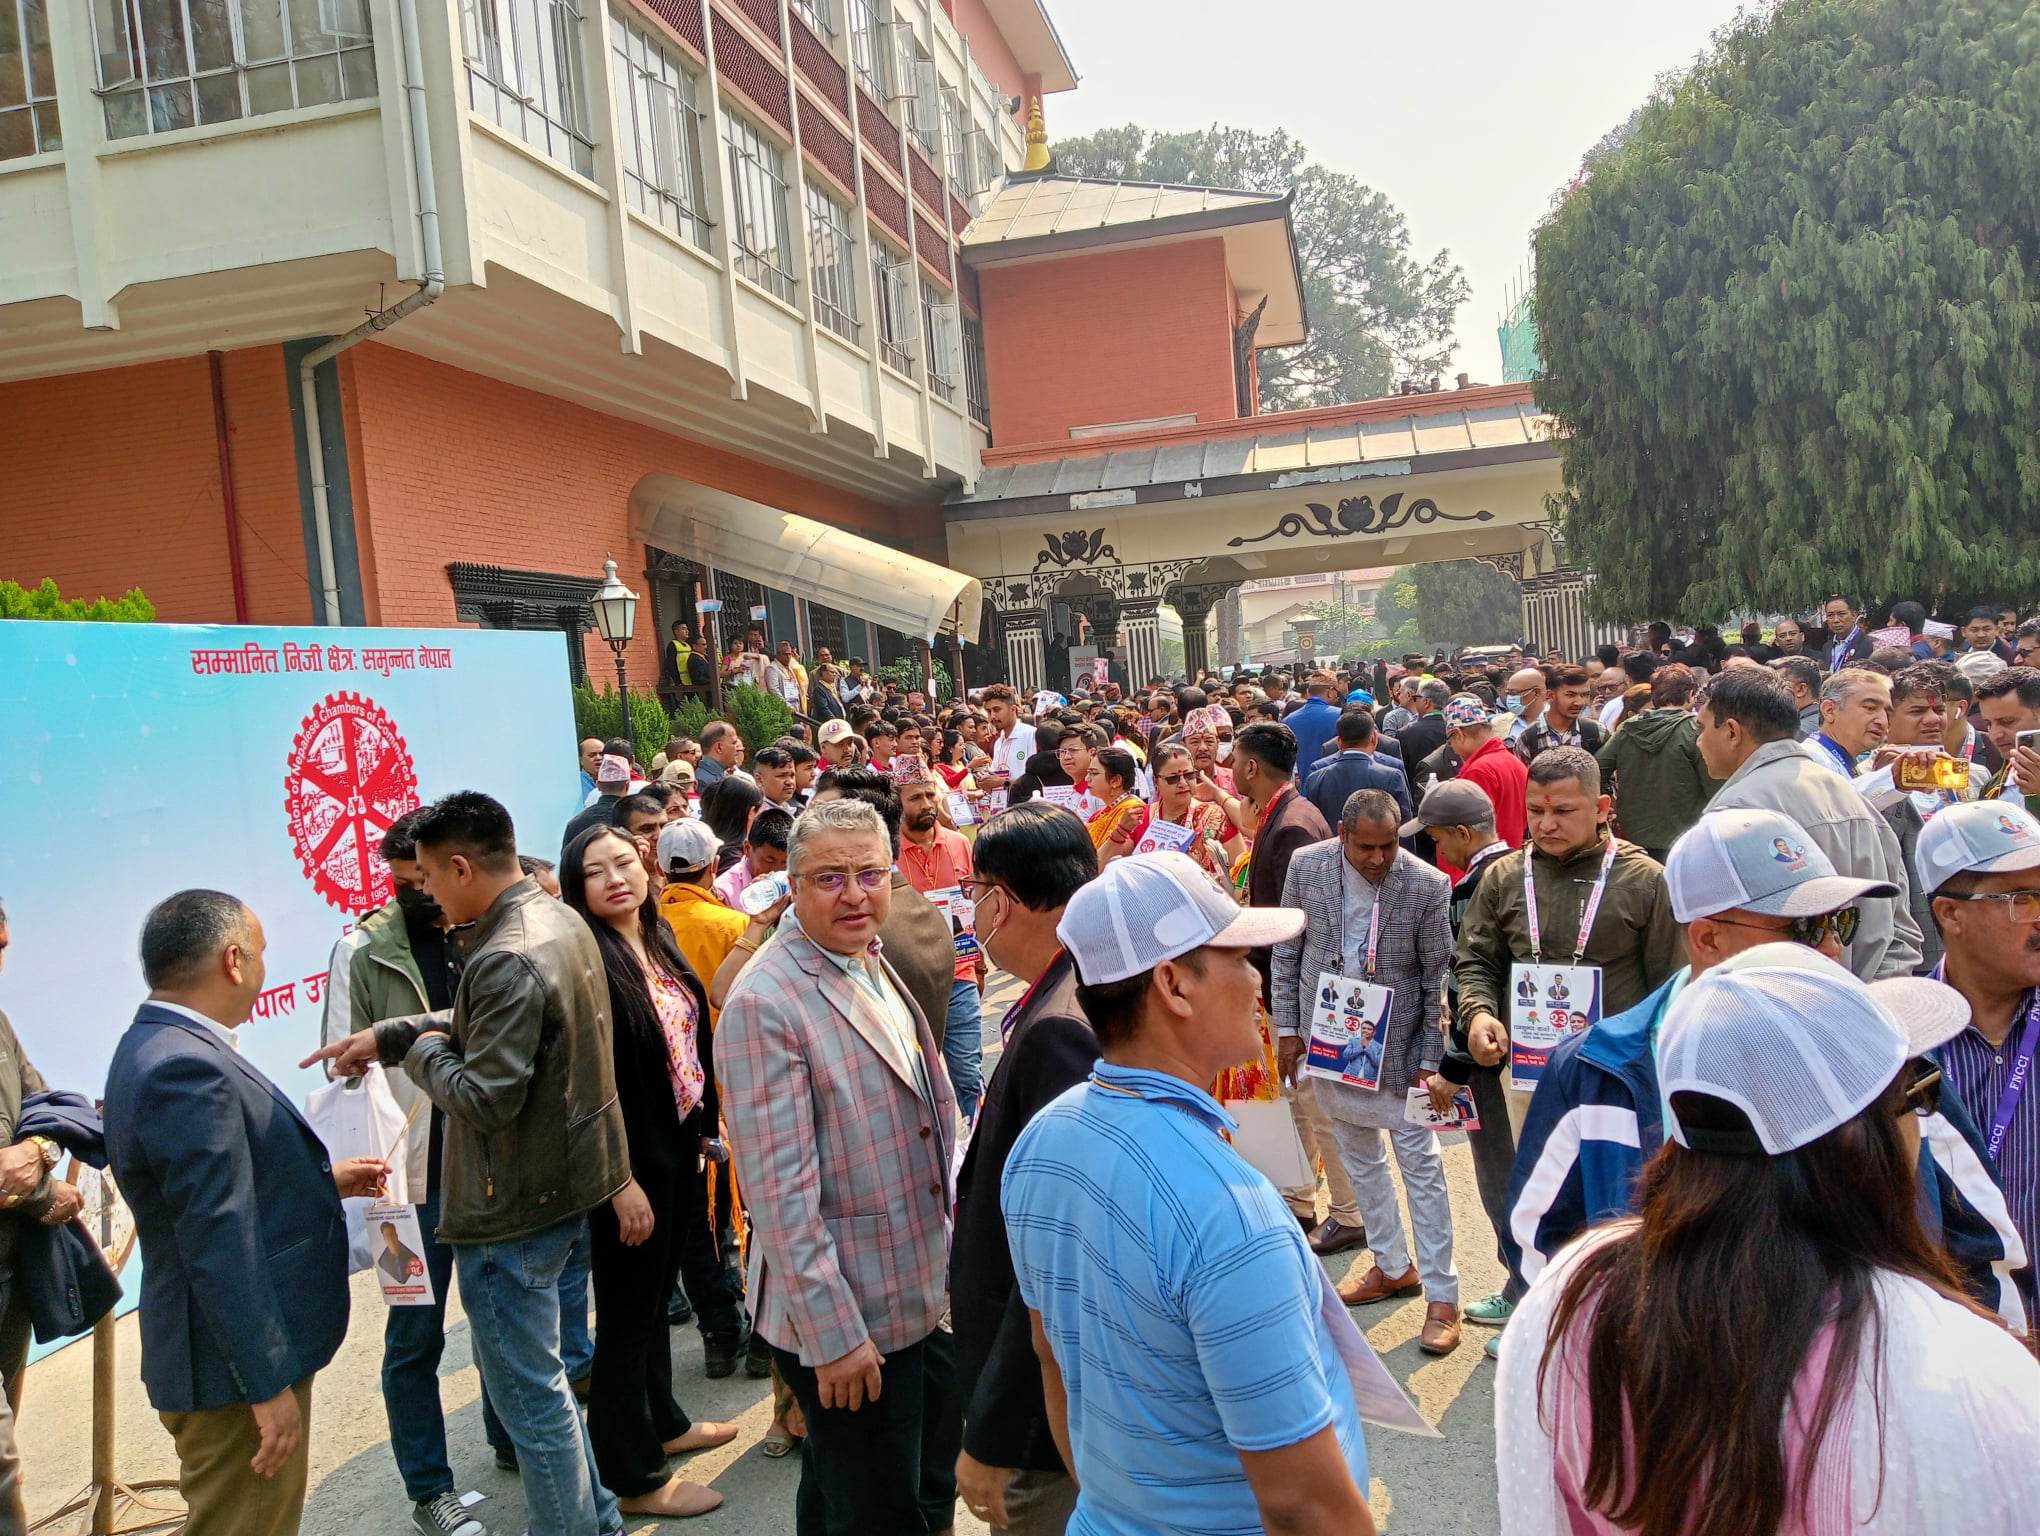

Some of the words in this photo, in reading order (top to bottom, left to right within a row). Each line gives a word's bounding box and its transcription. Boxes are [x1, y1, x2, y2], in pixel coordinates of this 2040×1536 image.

[191, 642, 279, 675] सम्मानित
[284, 642, 322, 672] निजी
[362, 648, 416, 677] समुन्नत
[418, 645, 451, 669] नेपाल
[319, 702, 365, 722] Chambers
[366, 711, 377, 721] of
[291, 719, 320, 777] Nepalese
[377, 718, 411, 780] Commerce
[290, 777, 300, 795] of
[292, 799, 320, 877] Federation
[371, 884, 389, 902] 1965
[241, 982, 296, 1024] पाल
[2009, 1055, 2029, 1090] FNCCI
